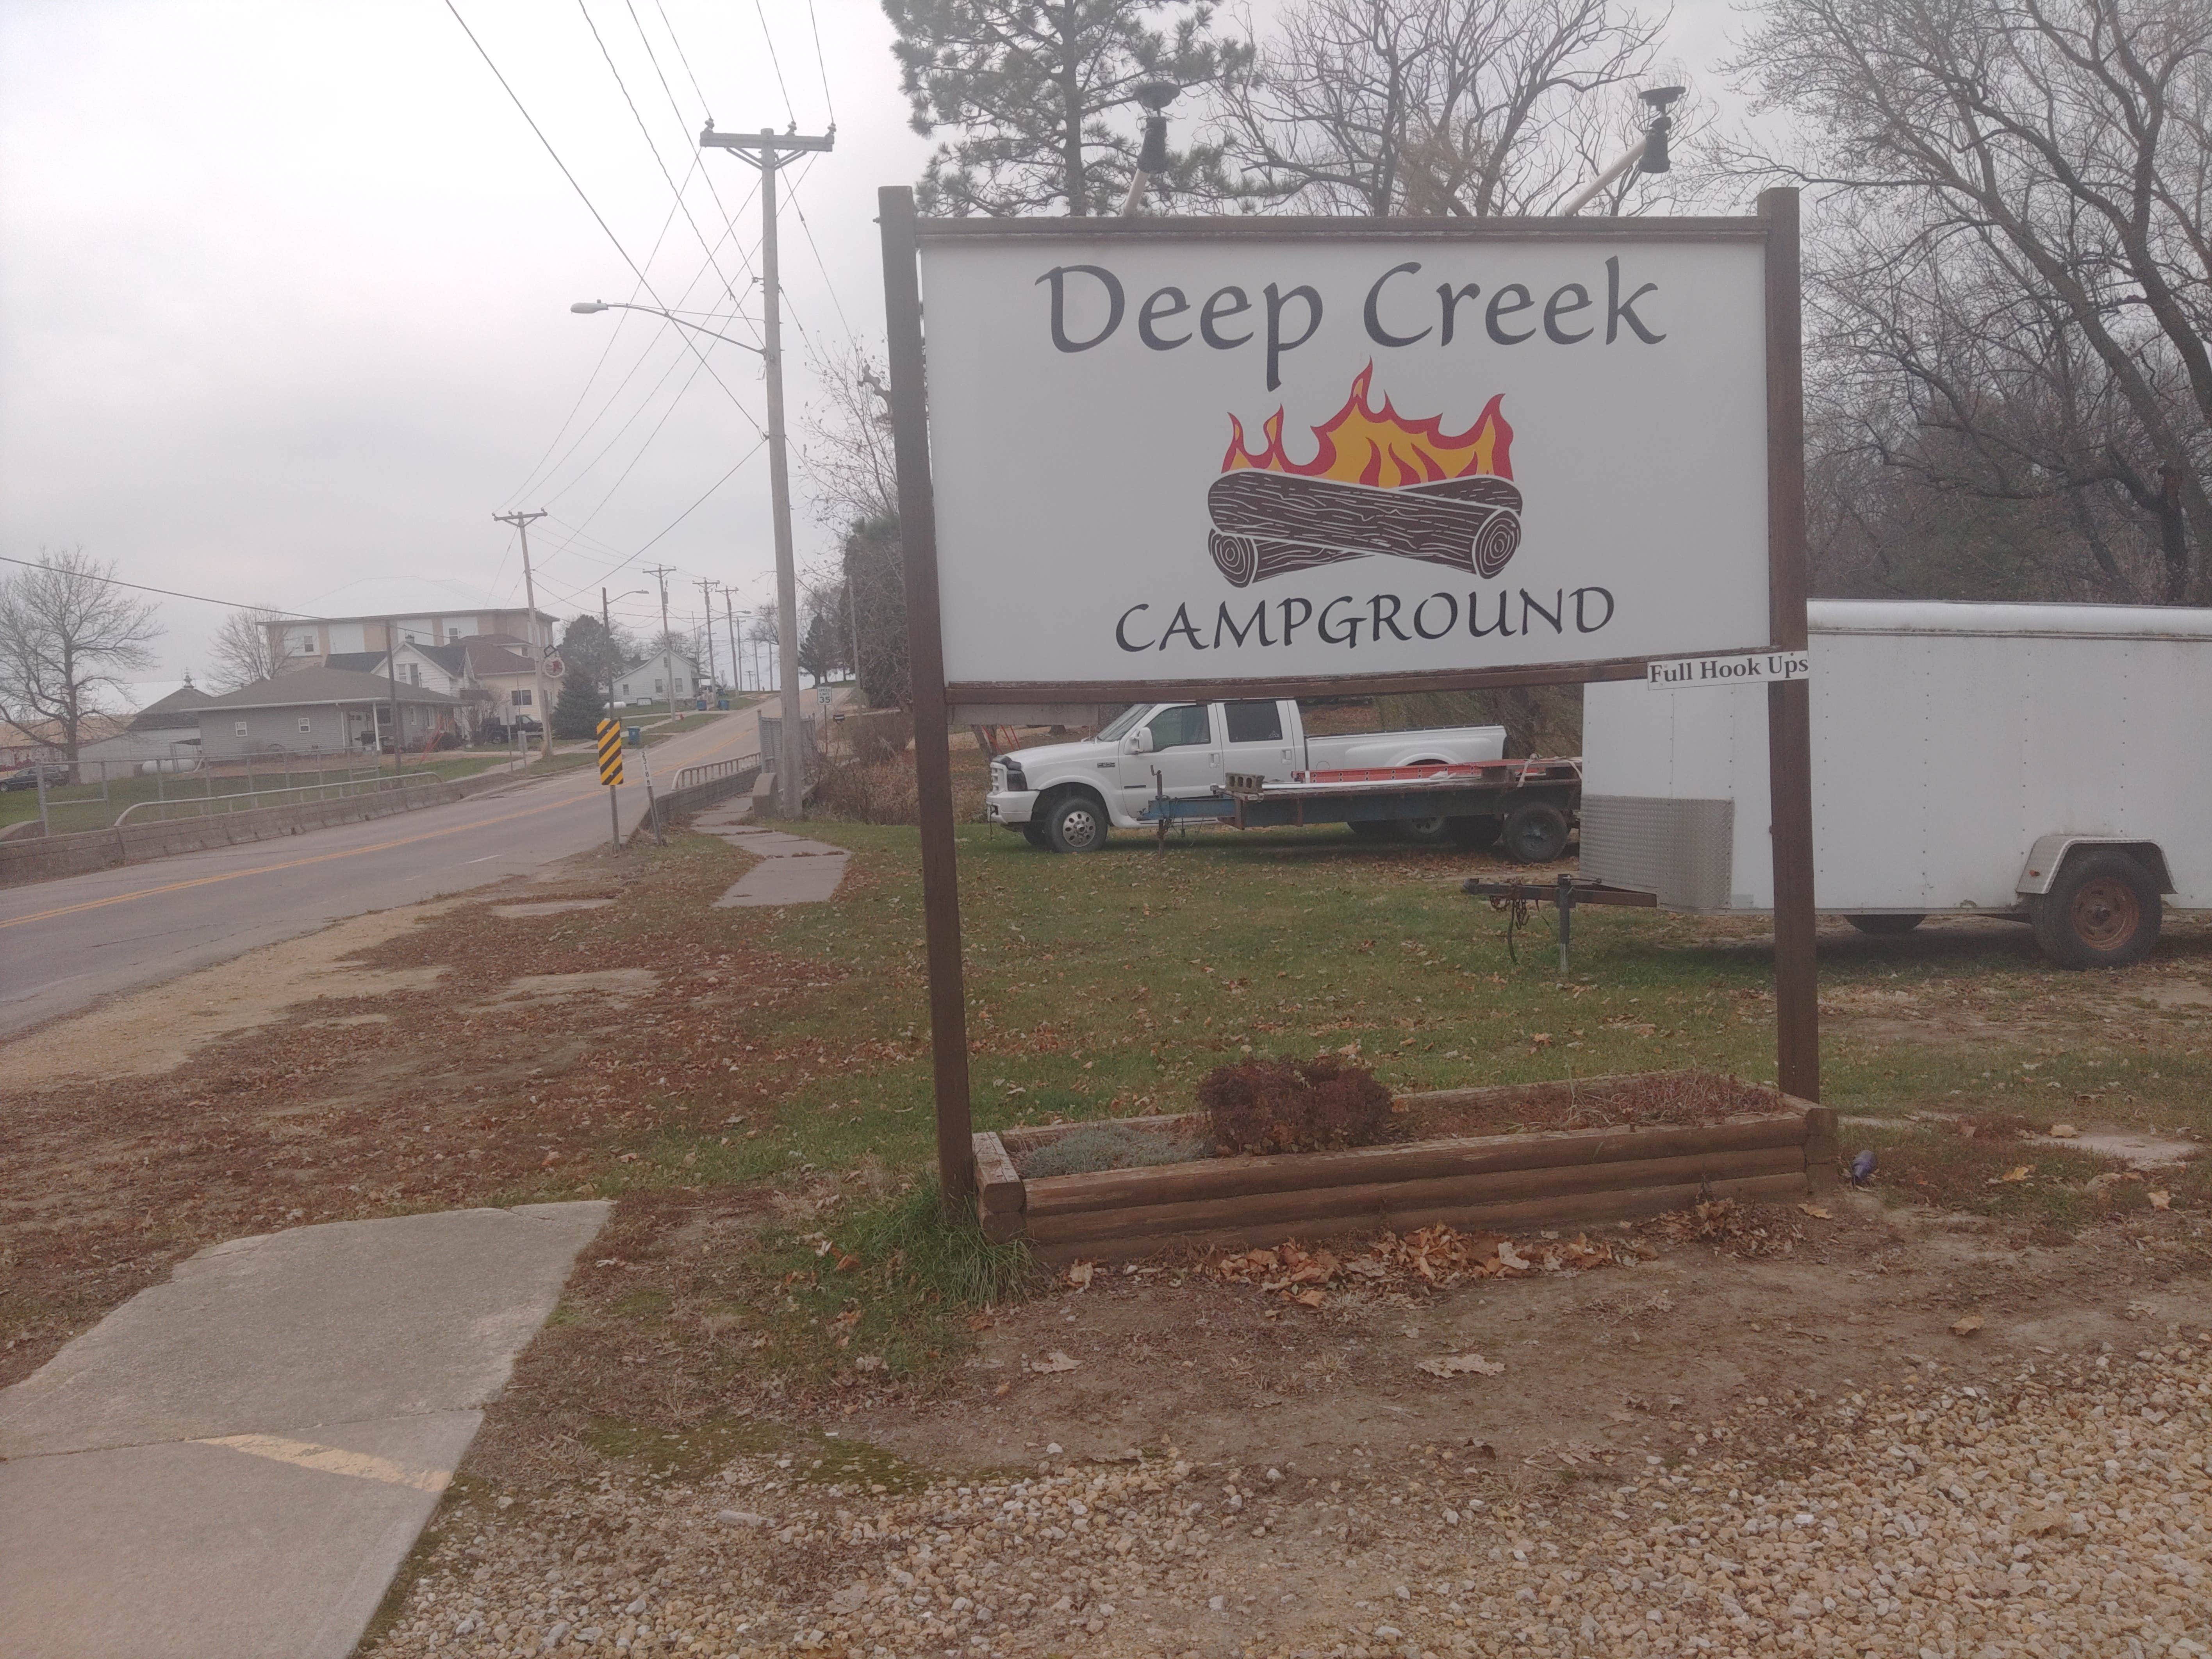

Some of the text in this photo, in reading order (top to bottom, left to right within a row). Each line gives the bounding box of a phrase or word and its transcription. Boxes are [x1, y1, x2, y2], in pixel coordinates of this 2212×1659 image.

[1035, 255, 1667, 392] Deep Creek
[1116, 587, 1614, 653] CAMPGROUND
[1650, 656, 1809, 683] Full Hook Ups
